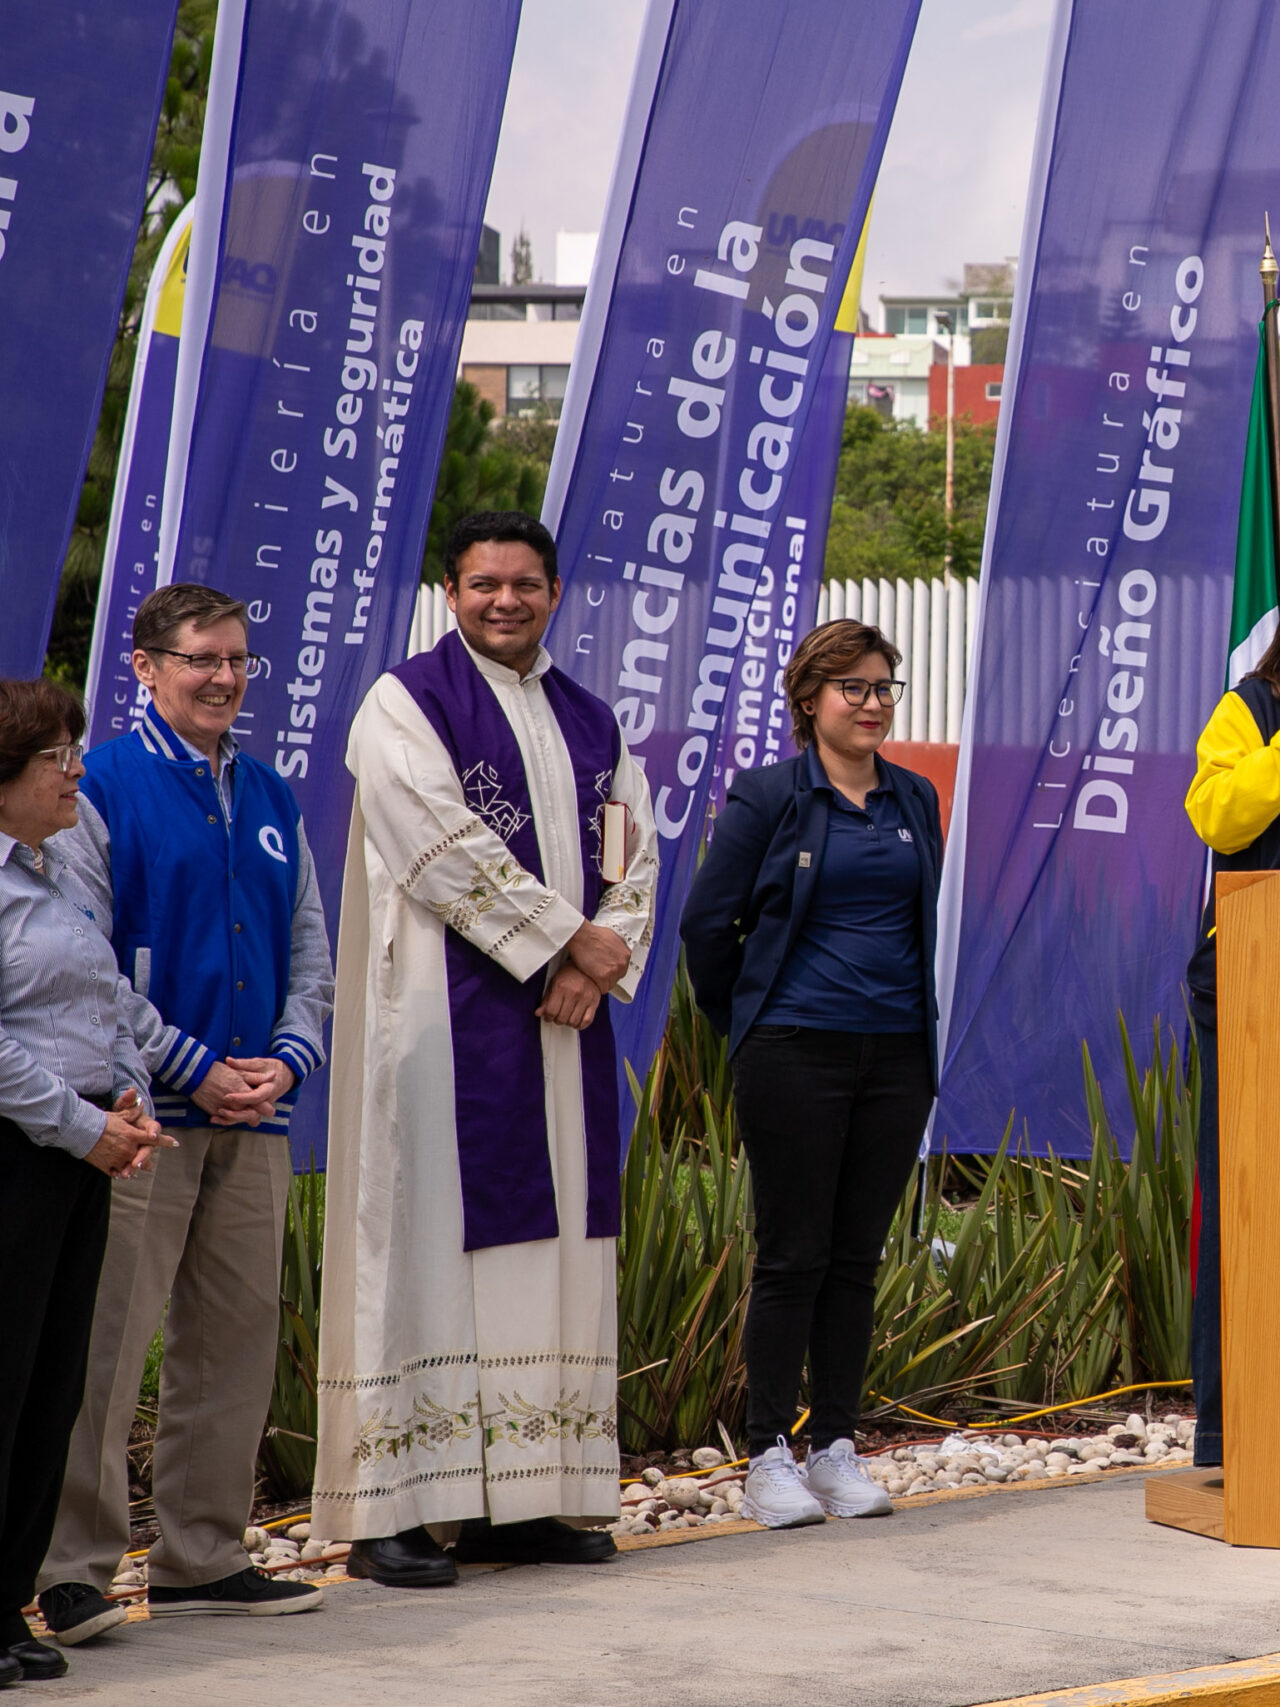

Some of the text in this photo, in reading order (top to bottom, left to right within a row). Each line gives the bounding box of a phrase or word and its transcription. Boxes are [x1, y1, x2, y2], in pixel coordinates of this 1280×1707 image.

[111, 562, 145, 729] nciatura
[141, 494, 157, 532] en
[229, 152, 339, 735] ngeniería en
[276, 163, 397, 779] Sistemas y Seguridad
[344, 319, 425, 645] Informática
[575, 205, 699, 655] nciatura en
[613, 218, 764, 772] encias de la
[654, 238, 835, 840] Comunicación
[1033, 244, 1149, 830] Licenciatura en
[1073, 254, 1205, 834] Diseño Gráfico
